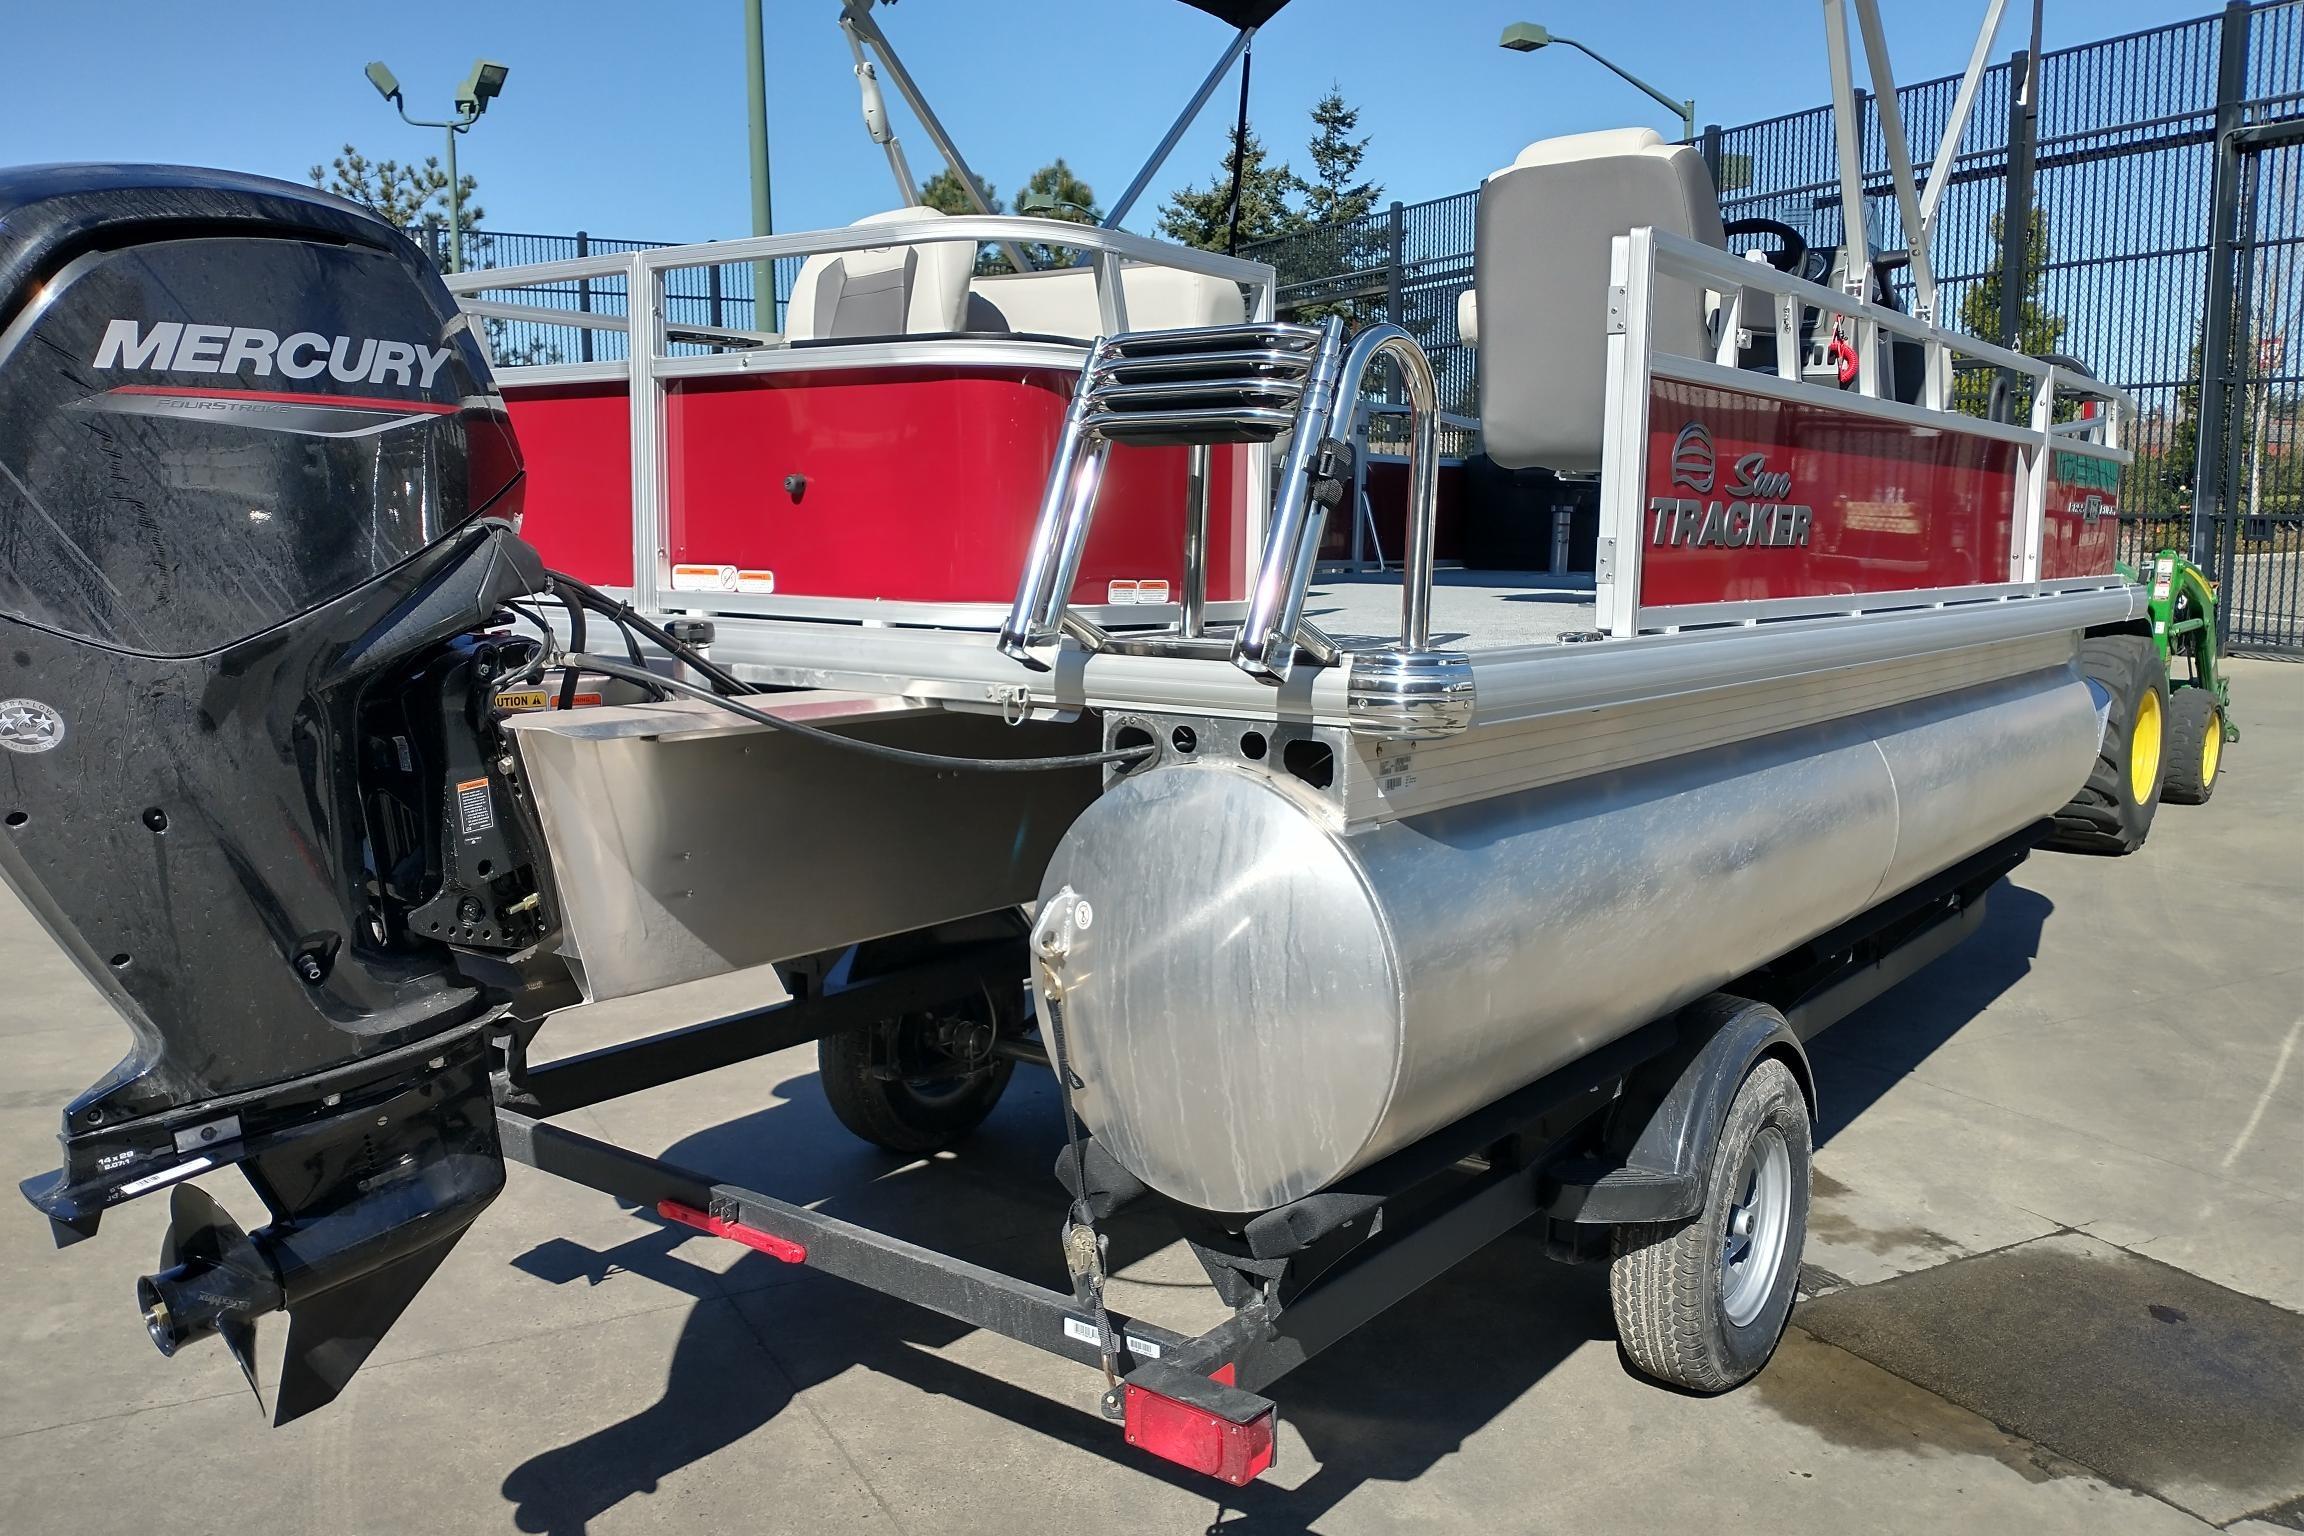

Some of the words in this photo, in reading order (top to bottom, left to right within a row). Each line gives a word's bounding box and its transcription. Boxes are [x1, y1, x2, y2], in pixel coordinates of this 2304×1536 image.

[93, 319, 452, 389] MERCURY
[157, 399, 291, 413] FOURSTROKE
[1725, 452, 1791, 499] Sun
[1650, 496, 1813, 548] TRACKER
[497, 696, 528, 707] UTION
[30, 702, 55, 716] LOW
[98, 1157, 111, 1165] 14
